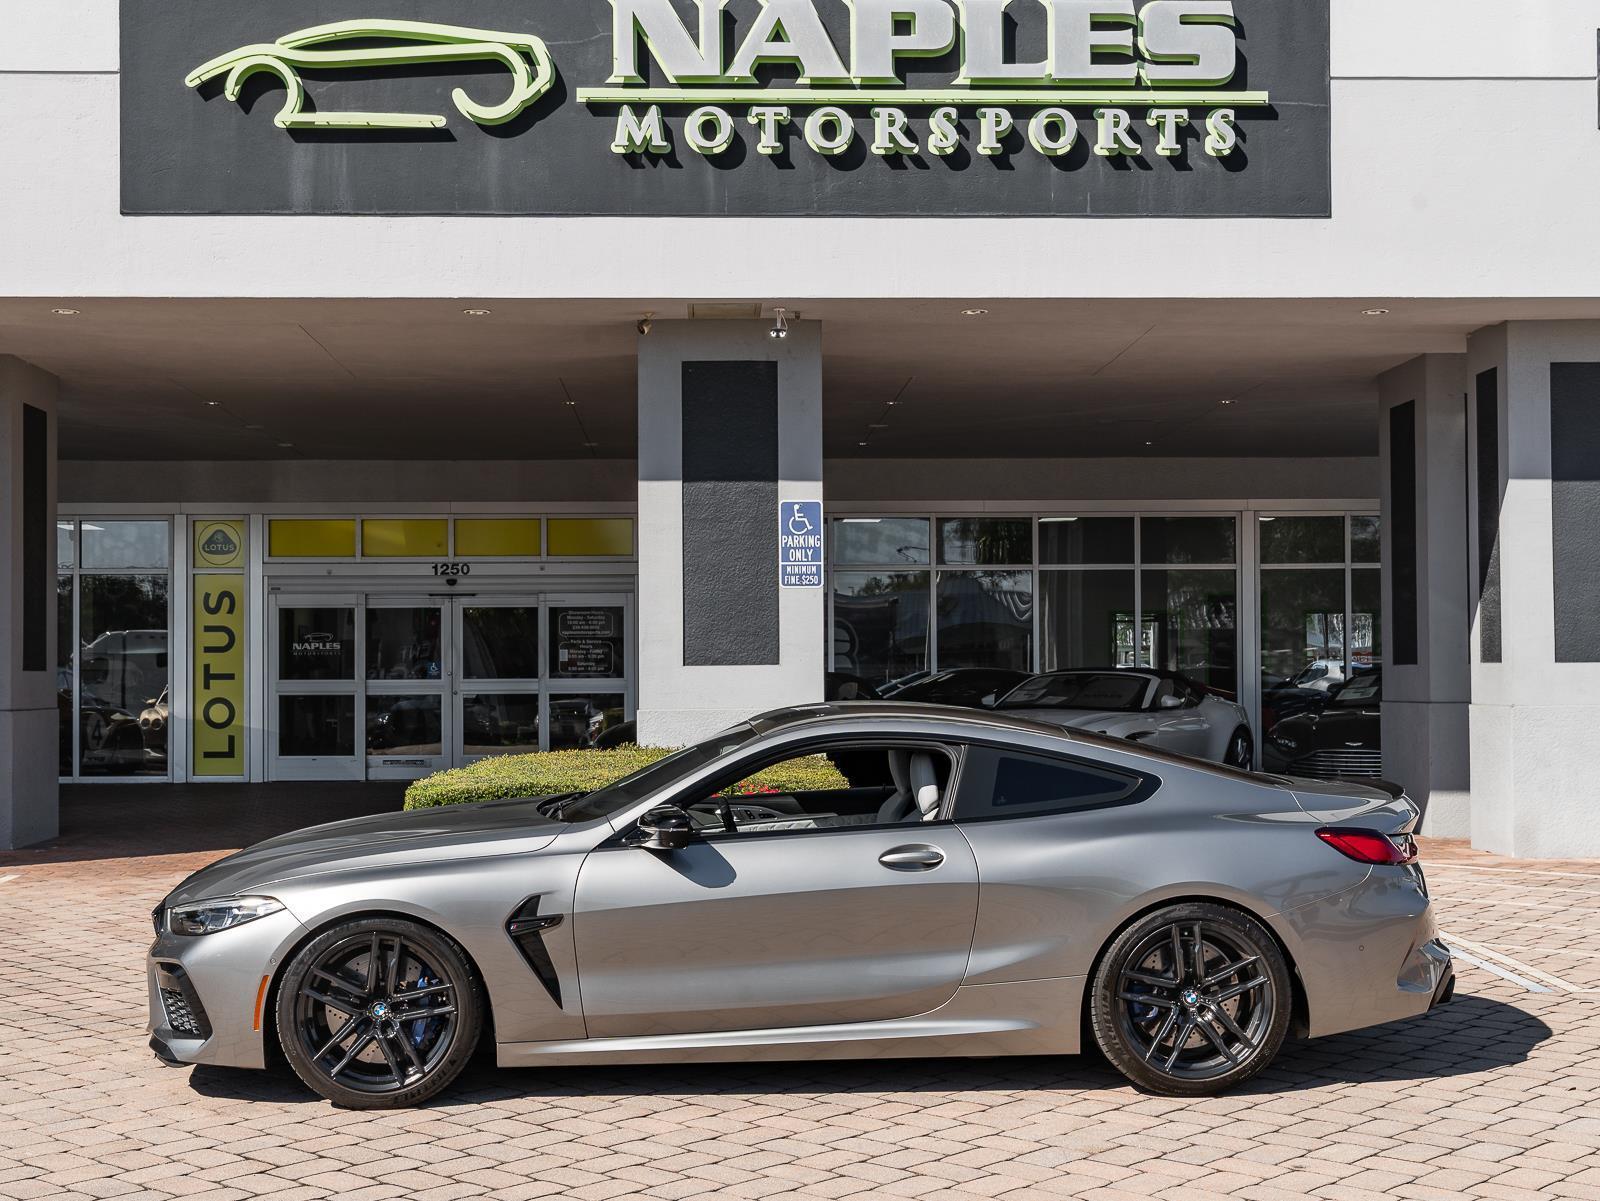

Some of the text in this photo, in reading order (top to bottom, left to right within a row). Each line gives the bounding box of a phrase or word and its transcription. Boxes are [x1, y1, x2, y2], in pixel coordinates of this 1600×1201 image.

[604, 0, 1238, 87] NAPLES
[610, 104, 1238, 157] MOTORSPORTS
[204, 543, 235, 551] LOTUS
[781, 535, 821, 548] PARKING
[789, 548, 813, 562] ONLY
[431, 562, 471, 576] 1250
[786, 565, 817, 575] MINIMUM
[784, 574, 819, 585] FINE $250
[292, 642, 341, 650] NAPLES
[202, 590, 236, 759] LOTUS
[92, 719, 103, 746] 4
